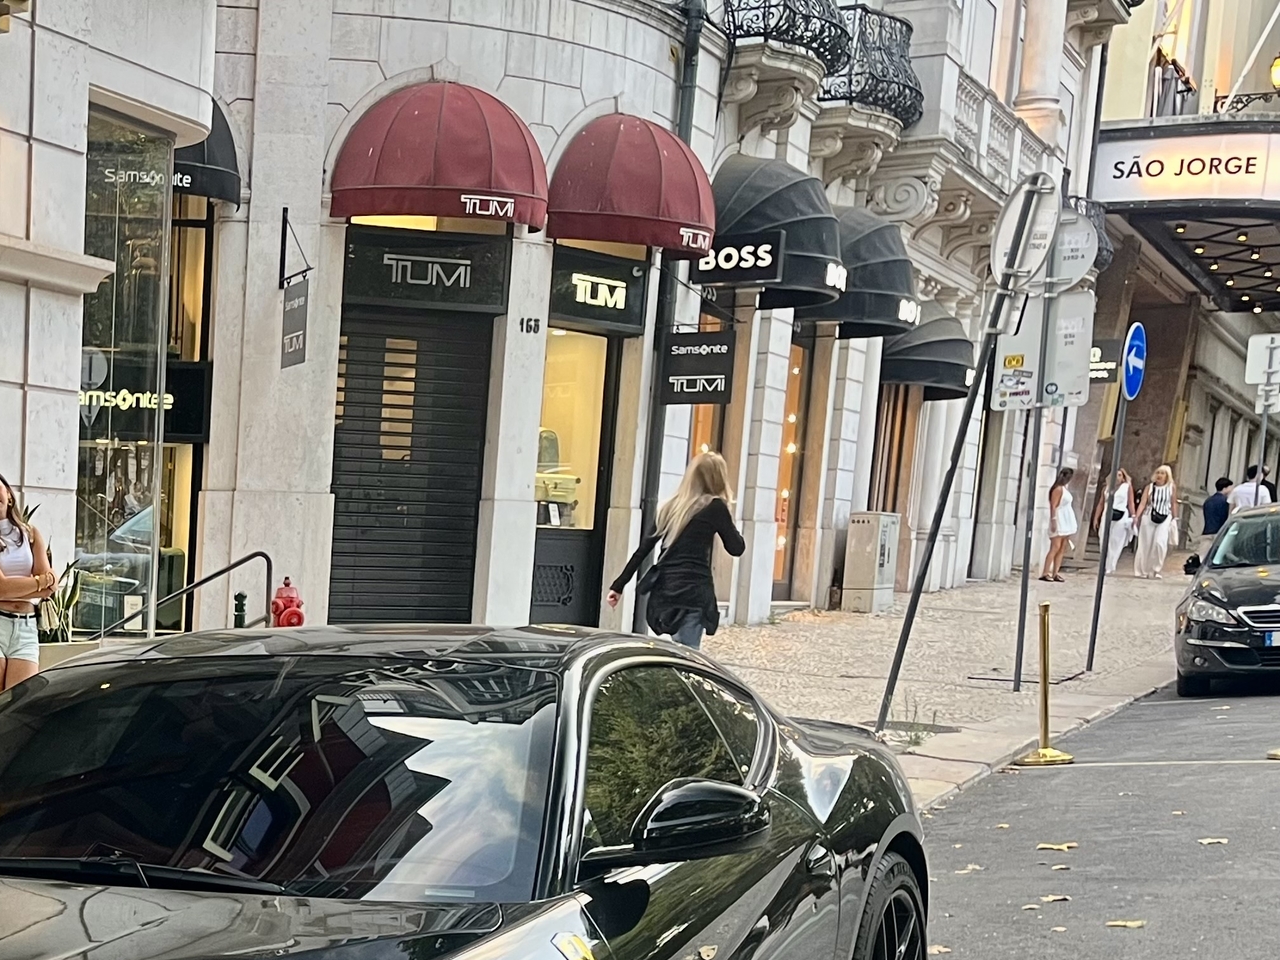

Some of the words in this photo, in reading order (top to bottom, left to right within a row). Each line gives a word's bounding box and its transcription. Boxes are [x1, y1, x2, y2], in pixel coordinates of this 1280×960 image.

[1113, 155, 1165, 179] SÃO
[1174, 157, 1257, 177] JORGE
[461, 194, 515, 217] TUMI
[698, 244, 773, 271] BOSS
[383, 253, 472, 288] TUMI
[671, 344, 728, 355] Samsonite
[669, 375, 726, 393] TUMI
